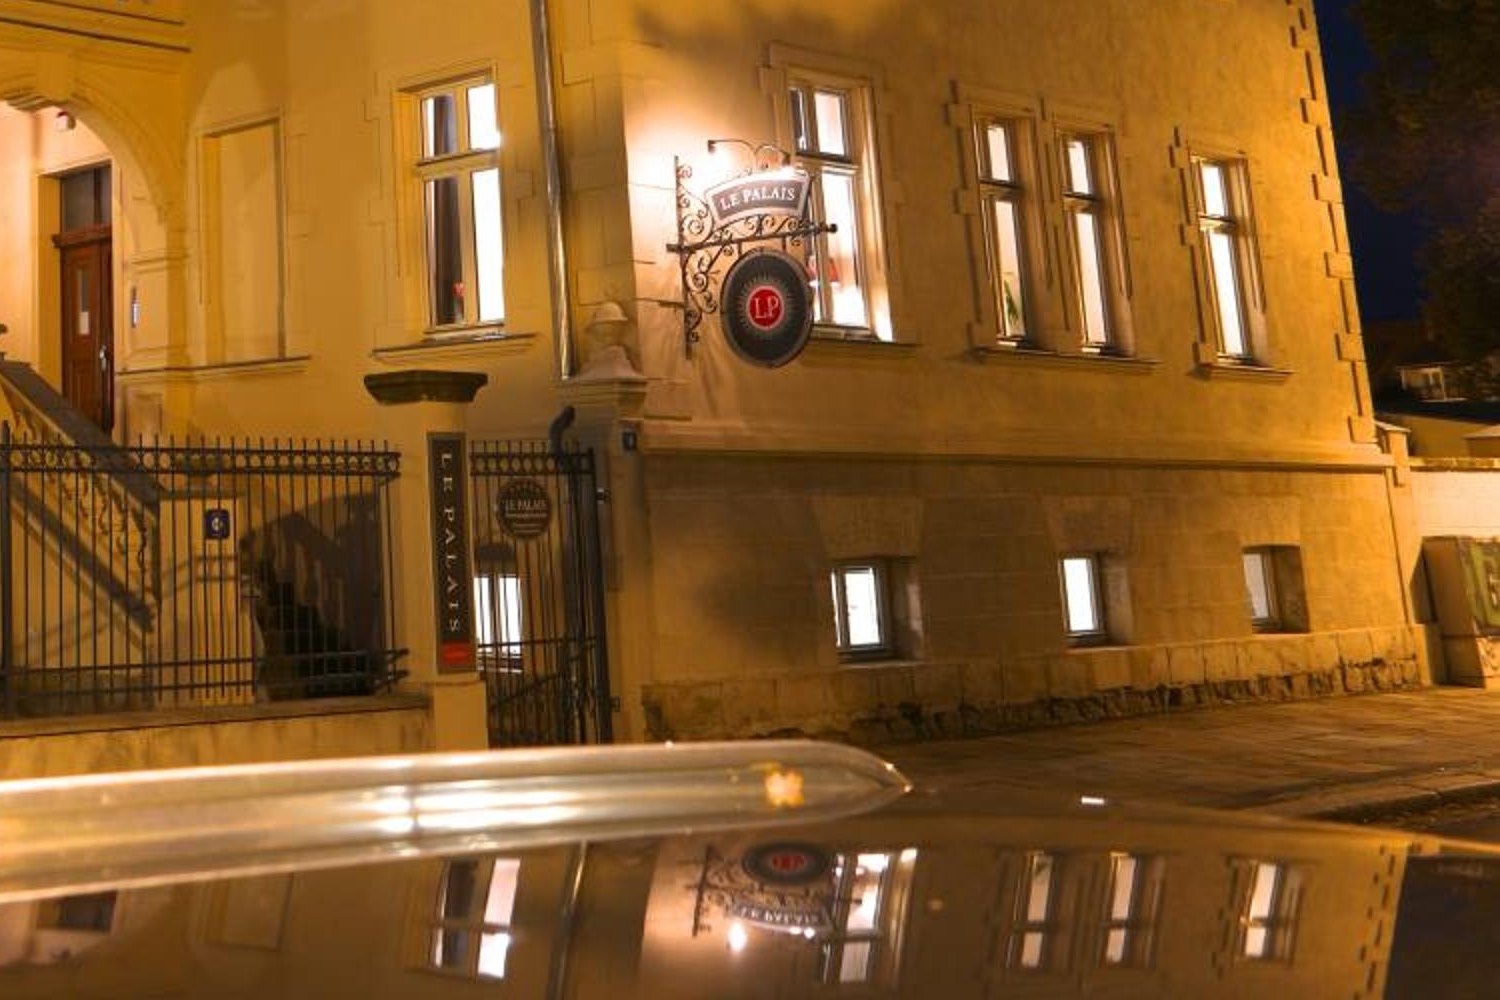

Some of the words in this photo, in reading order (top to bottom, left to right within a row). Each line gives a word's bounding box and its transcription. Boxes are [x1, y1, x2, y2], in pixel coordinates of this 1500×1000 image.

[720, 194, 740, 210] LE
[742, 186, 796, 203] PALAIS
[754, 298, 779, 319] LP
[441, 453, 453, 492] LE
[444, 506, 460, 632] PALAIS
